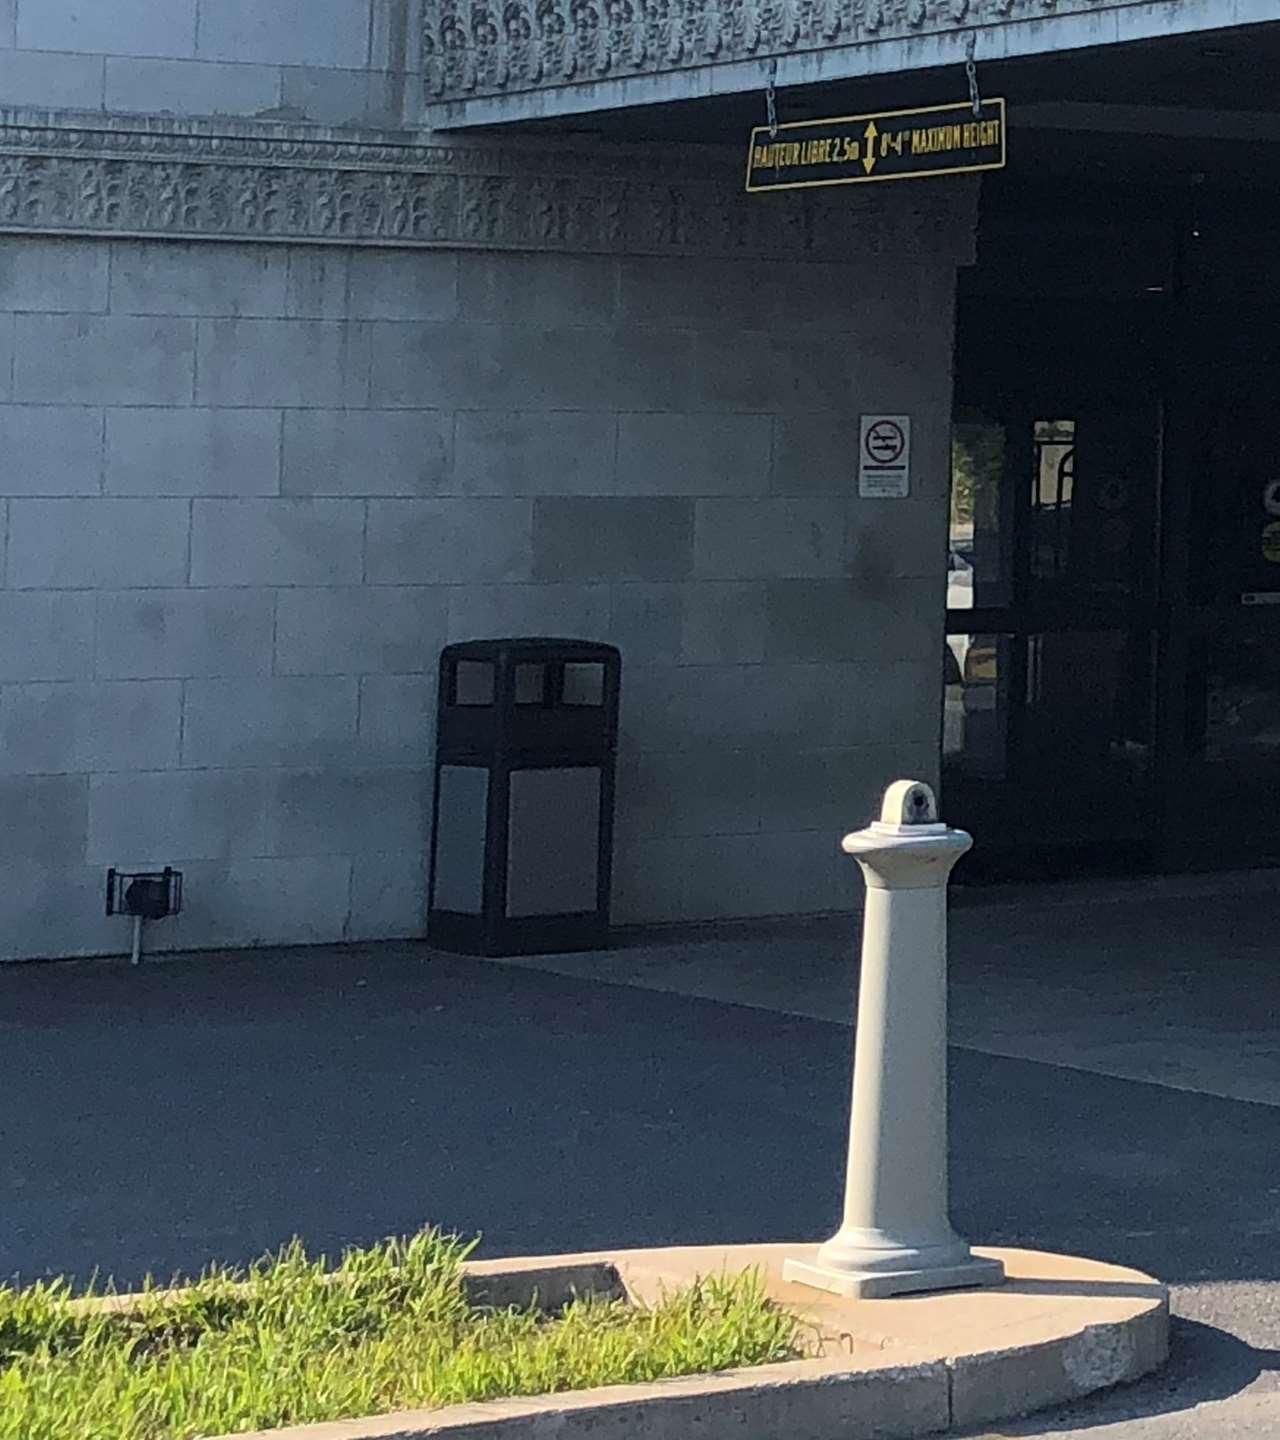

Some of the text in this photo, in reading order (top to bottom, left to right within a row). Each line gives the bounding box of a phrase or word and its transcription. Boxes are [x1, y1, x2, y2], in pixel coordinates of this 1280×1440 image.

[753, 142, 801, 168] HAUTEUR
[801, 138, 832, 165] LIBRE
[911, 125, 961, 155] MAXIMUM
[963, 120, 1000, 149] HEIGHT
